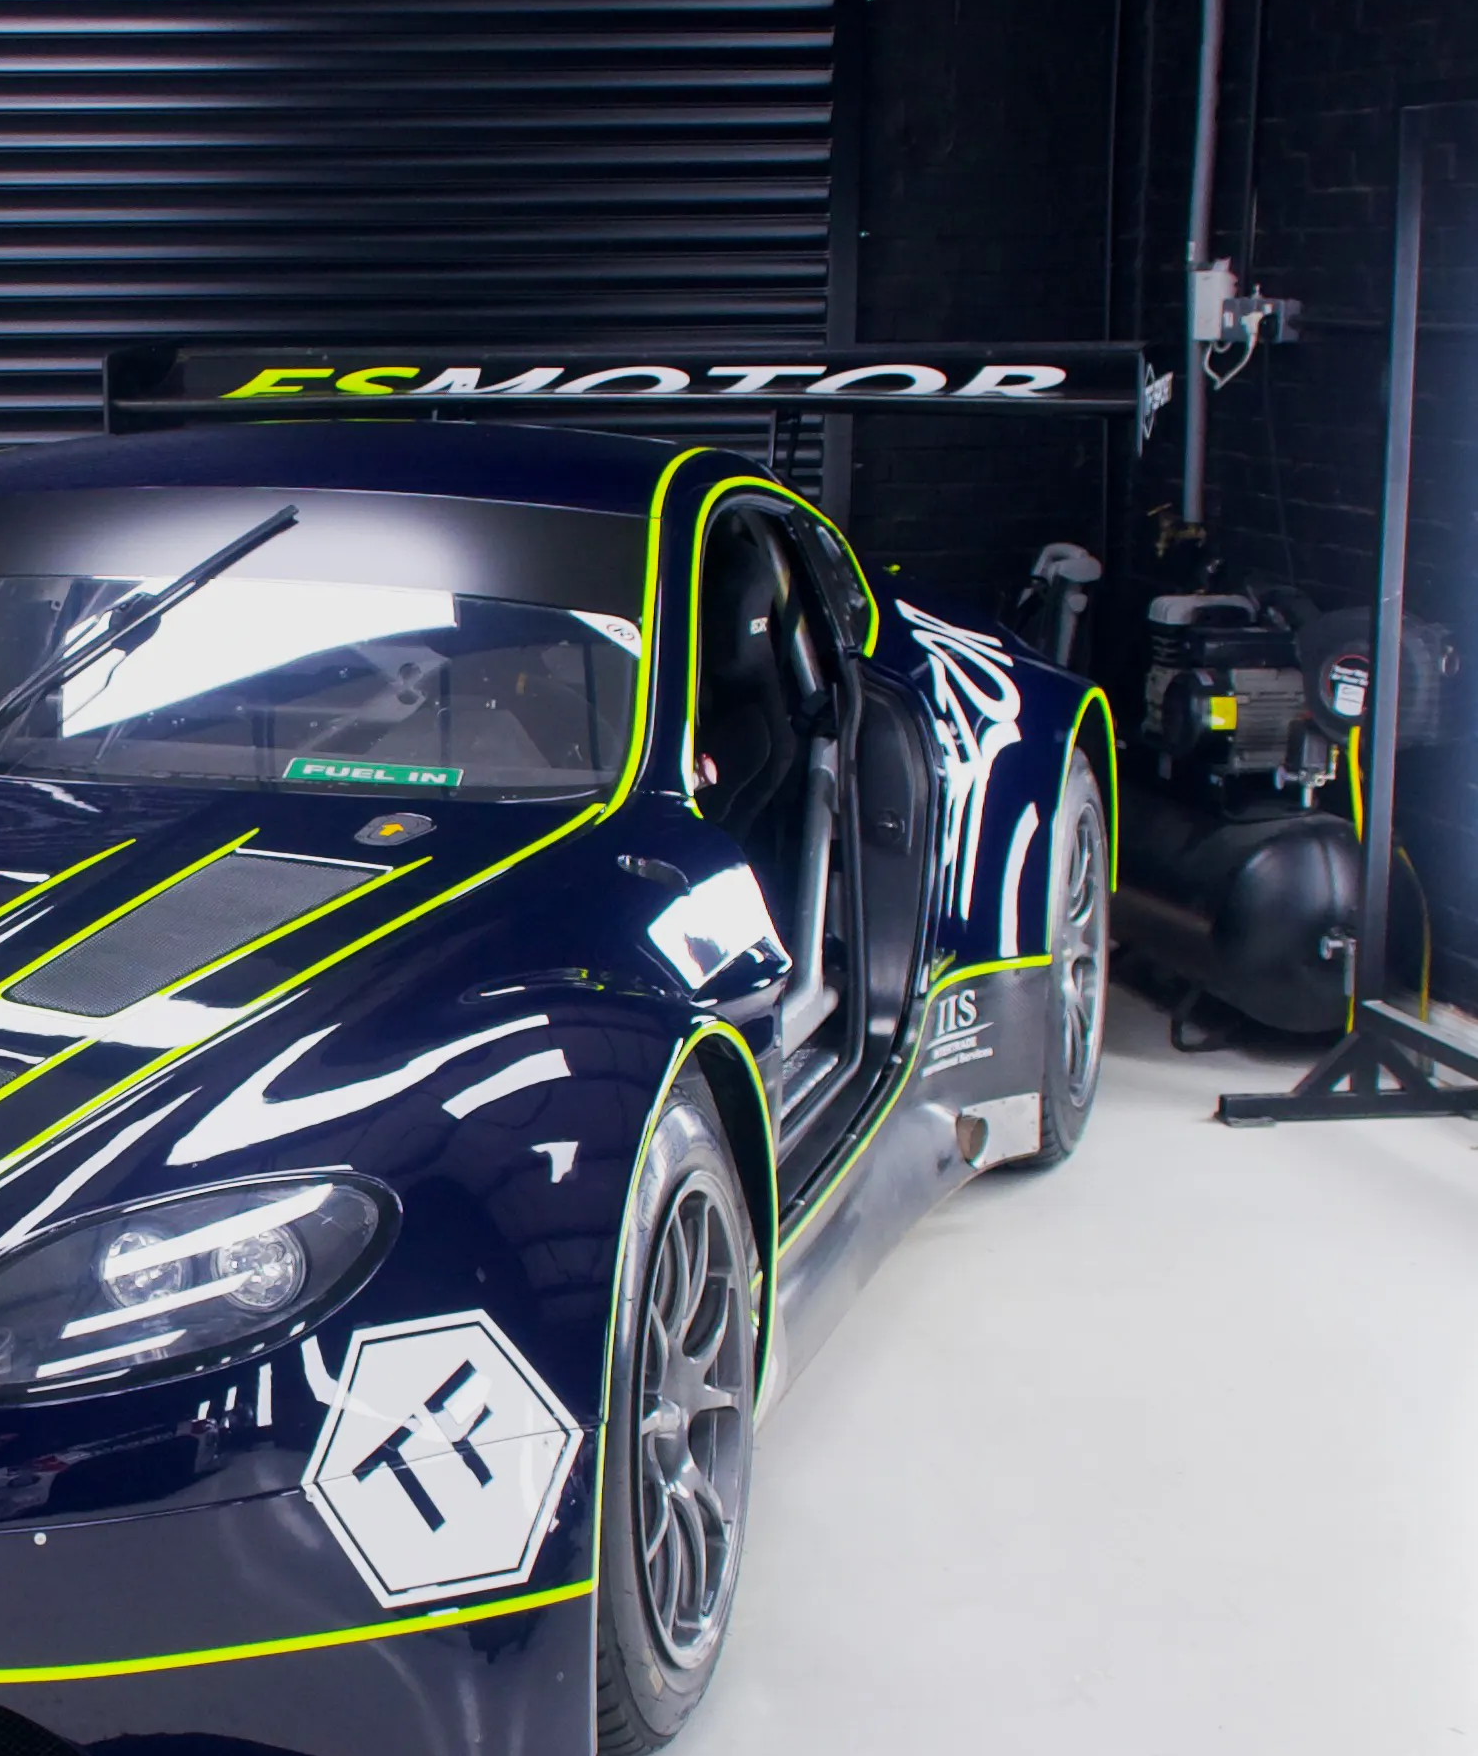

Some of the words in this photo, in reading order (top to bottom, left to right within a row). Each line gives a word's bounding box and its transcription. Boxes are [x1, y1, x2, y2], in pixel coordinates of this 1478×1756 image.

[302, 764, 395, 781] FUEL
[408, 771, 447, 784] IN
[935, 989, 978, 1038] IIS
[351, 1358, 494, 1534] TF
